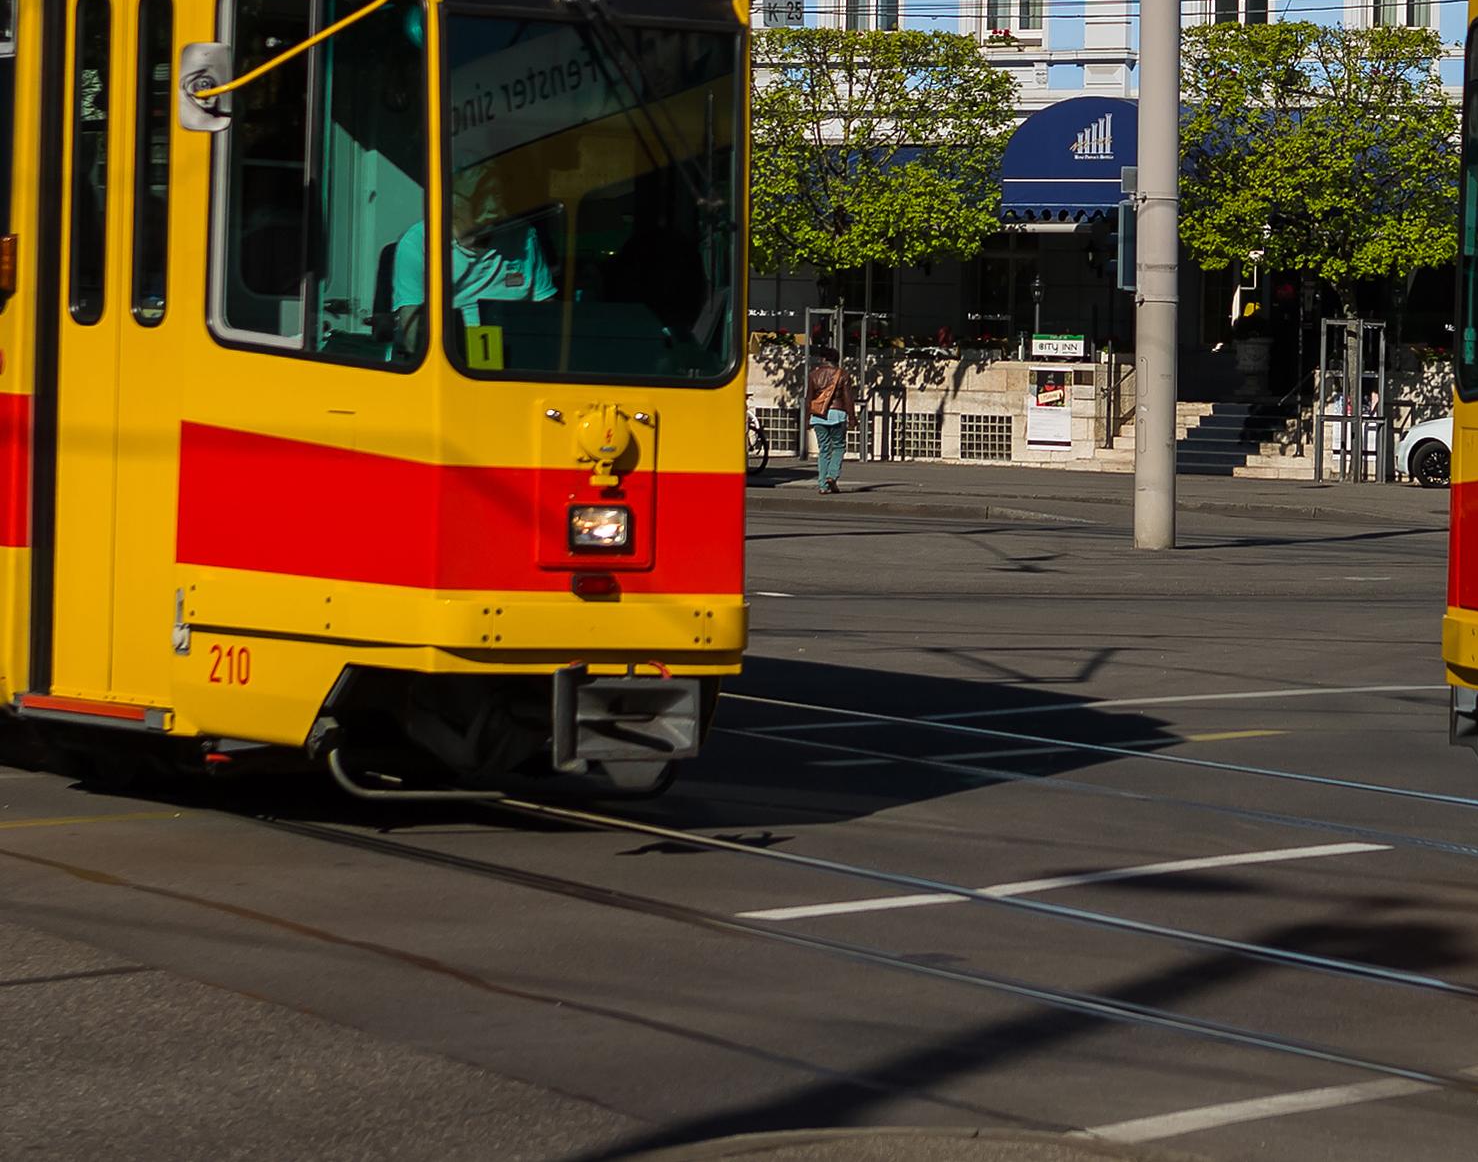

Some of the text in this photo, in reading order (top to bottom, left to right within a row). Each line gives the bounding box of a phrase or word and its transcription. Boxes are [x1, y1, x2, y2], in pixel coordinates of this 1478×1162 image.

[786, 1, 803, 21] 25
[478, 332, 490, 362] 1
[209, 643, 251, 686] 210
